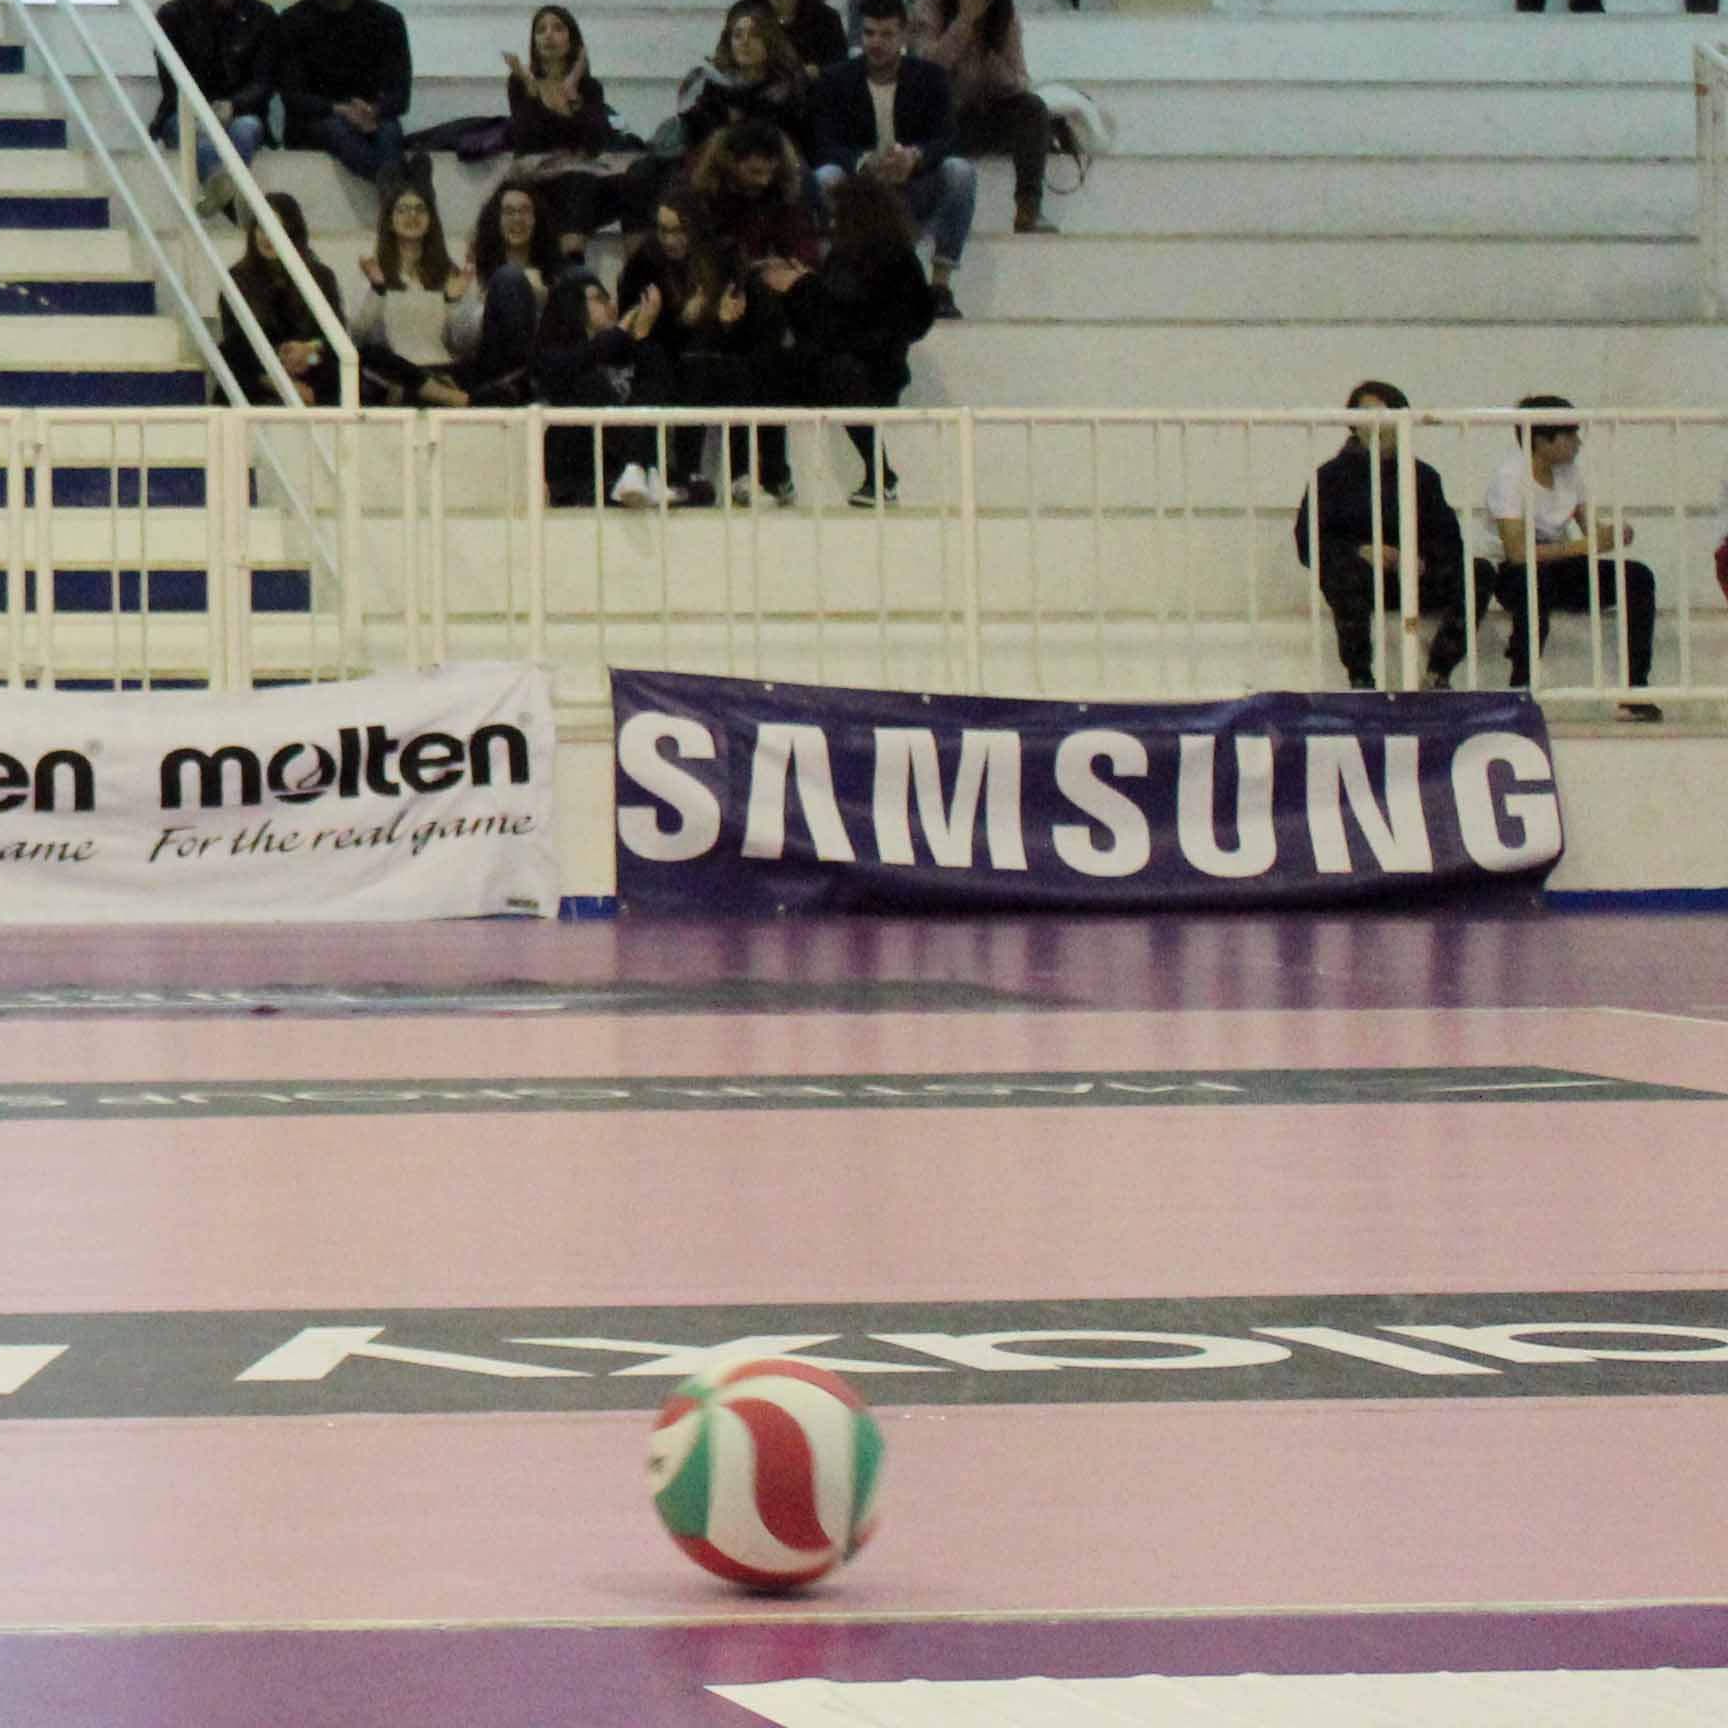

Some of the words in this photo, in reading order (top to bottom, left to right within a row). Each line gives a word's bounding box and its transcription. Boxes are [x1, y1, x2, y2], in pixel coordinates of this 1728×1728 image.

[159, 722, 531, 810] molten
[616, 710, 1564, 878] SAMSUNG
[149, 823, 222, 864] For
[232, 813, 303, 857] the
[309, 808, 402, 854] real
[411, 811, 536, 858] game
[233, 1321, 1728, 1382] alaxy
